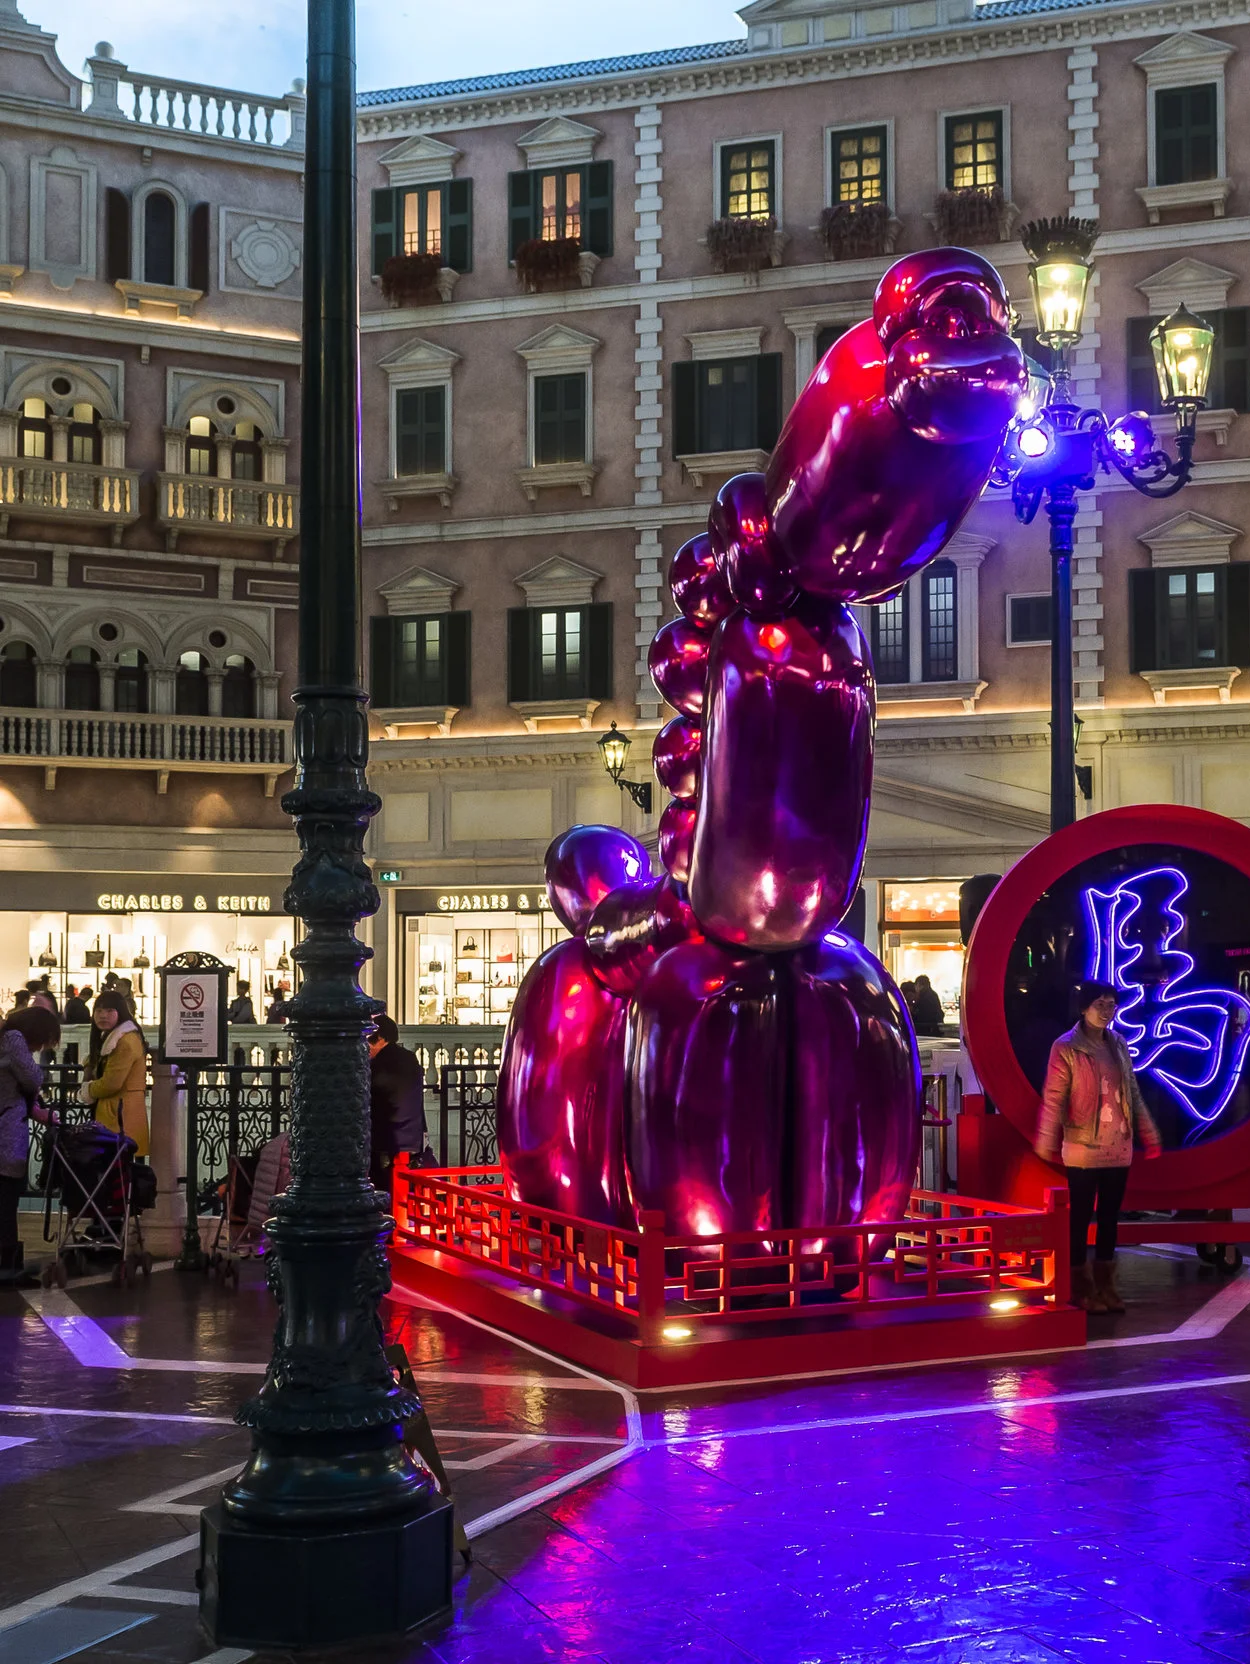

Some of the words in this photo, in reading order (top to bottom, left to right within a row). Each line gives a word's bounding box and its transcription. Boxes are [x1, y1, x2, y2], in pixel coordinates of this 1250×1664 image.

[97, 894, 183, 911] CHARLES
[193, 895, 208, 911] &
[217, 896, 271, 911] KEITH
[437, 894, 509, 911] CHARLES
[517, 894, 530, 910] &
